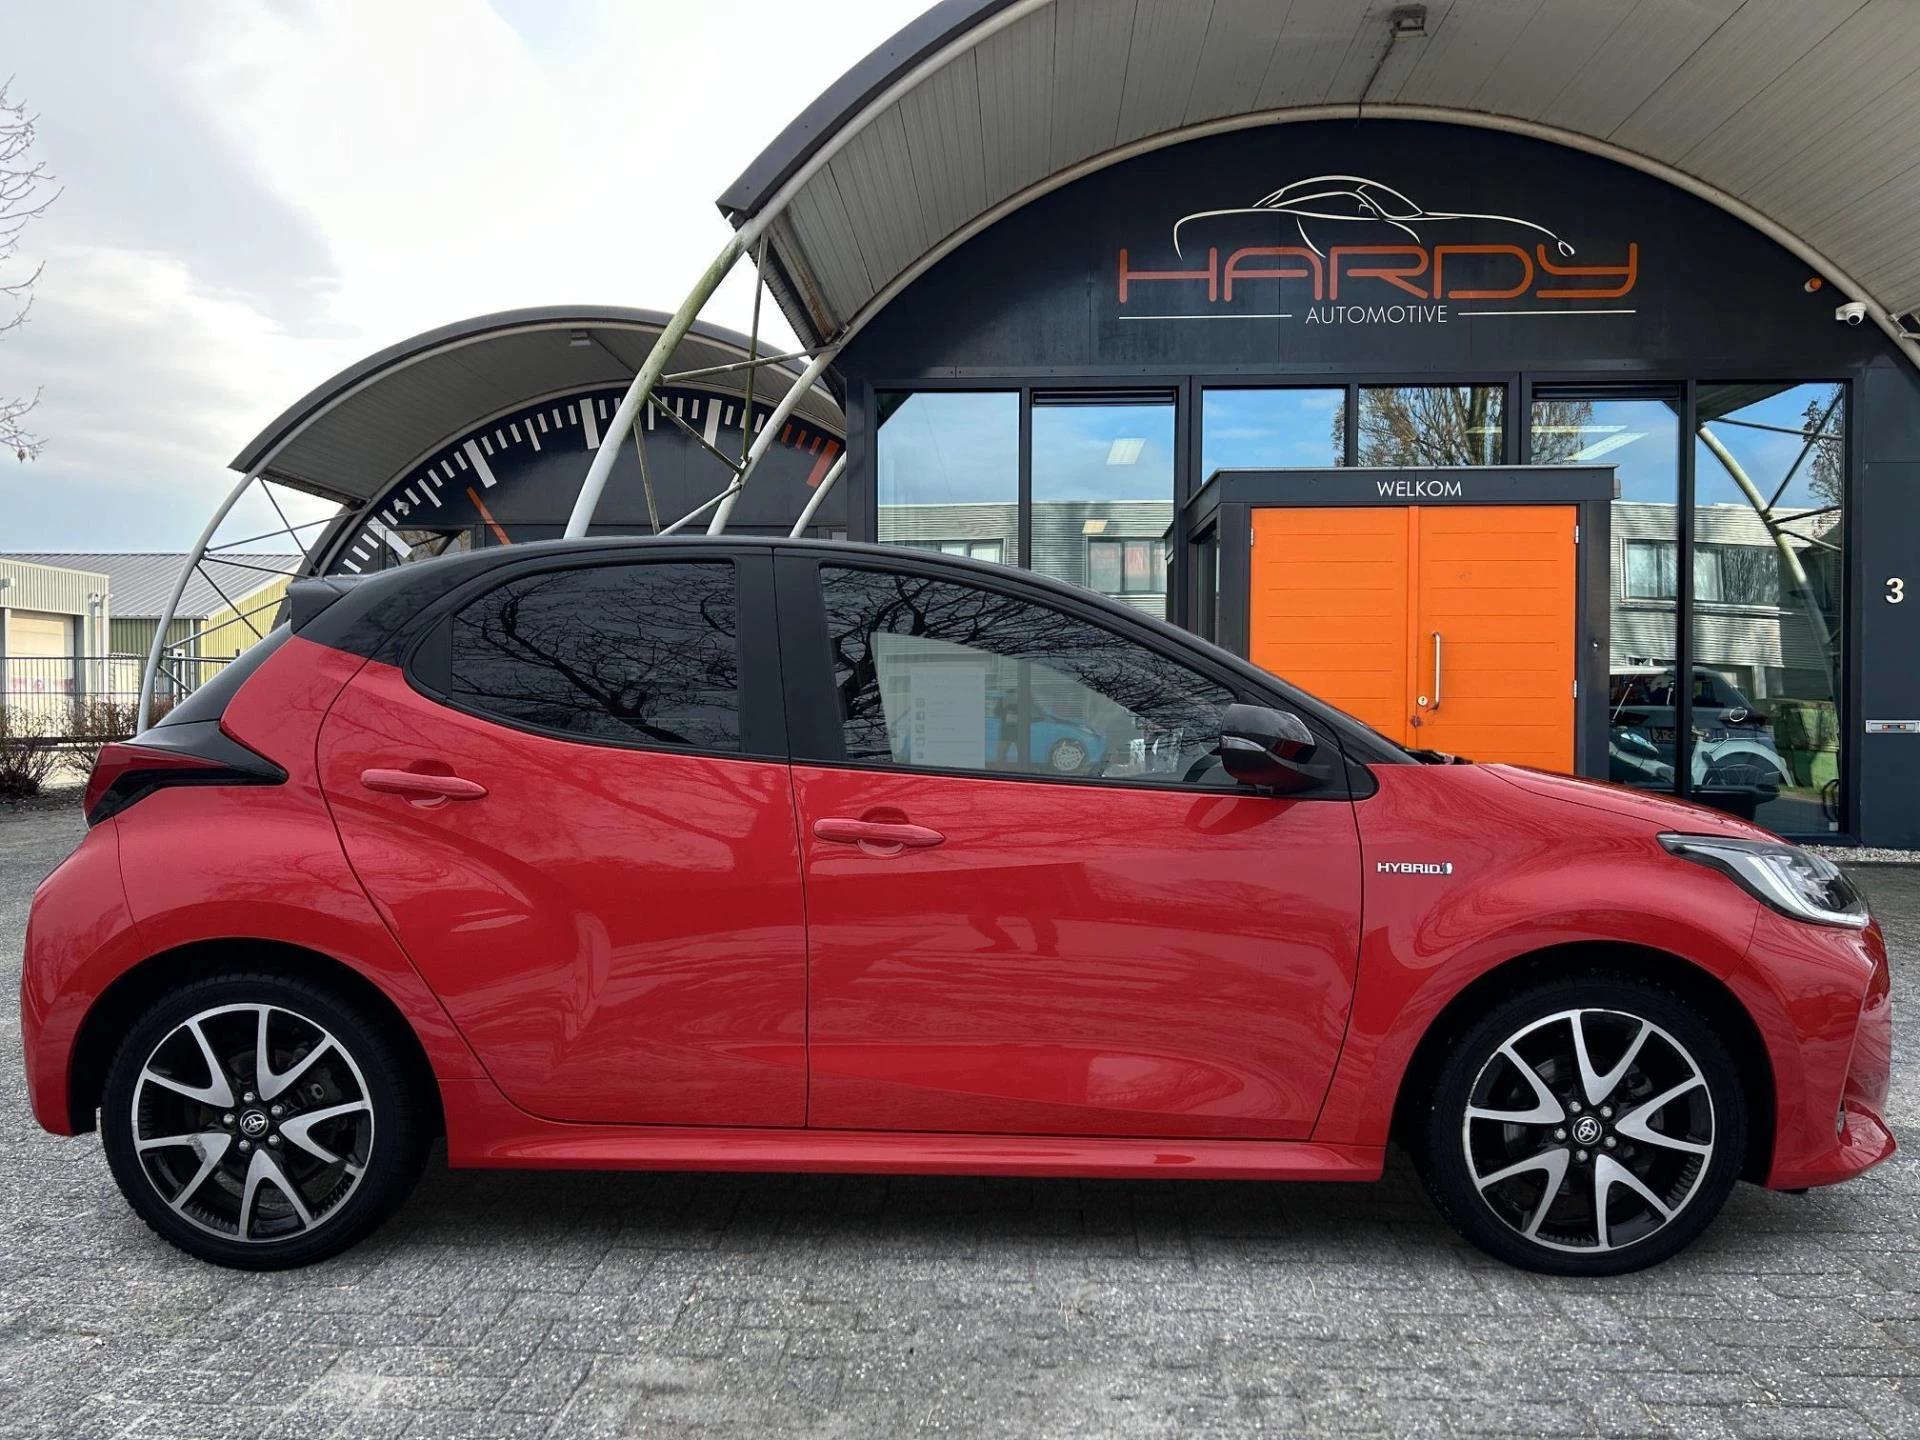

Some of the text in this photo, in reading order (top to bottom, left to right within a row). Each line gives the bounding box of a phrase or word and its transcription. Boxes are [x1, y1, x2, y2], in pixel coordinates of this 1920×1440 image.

[1119, 242, 1638, 303] HARDY
[1305, 305, 1448, 325] AUTOMOTIVE
[1376, 480, 1462, 497] WELKOM
[1885, 577, 1904, 604] 3
[1377, 862, 1441, 874] HYBRID
